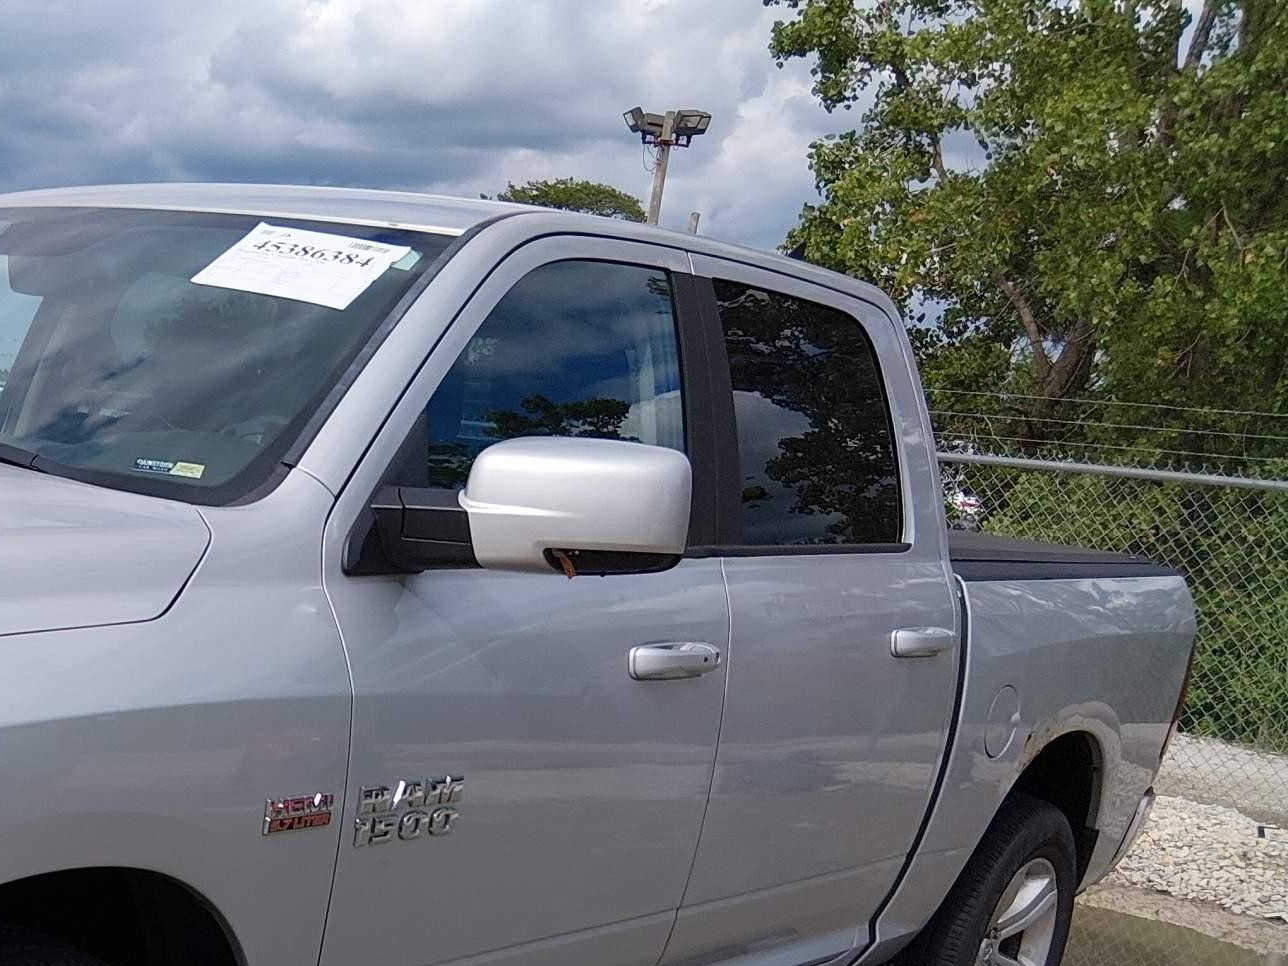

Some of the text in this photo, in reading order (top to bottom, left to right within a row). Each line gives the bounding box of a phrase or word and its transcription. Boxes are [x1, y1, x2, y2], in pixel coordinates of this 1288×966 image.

[253, 240, 375, 268] 45386384
[265, 792, 334, 818] HEMI
[357, 775, 465, 815] RAM
[353, 807, 460, 849] 1500
